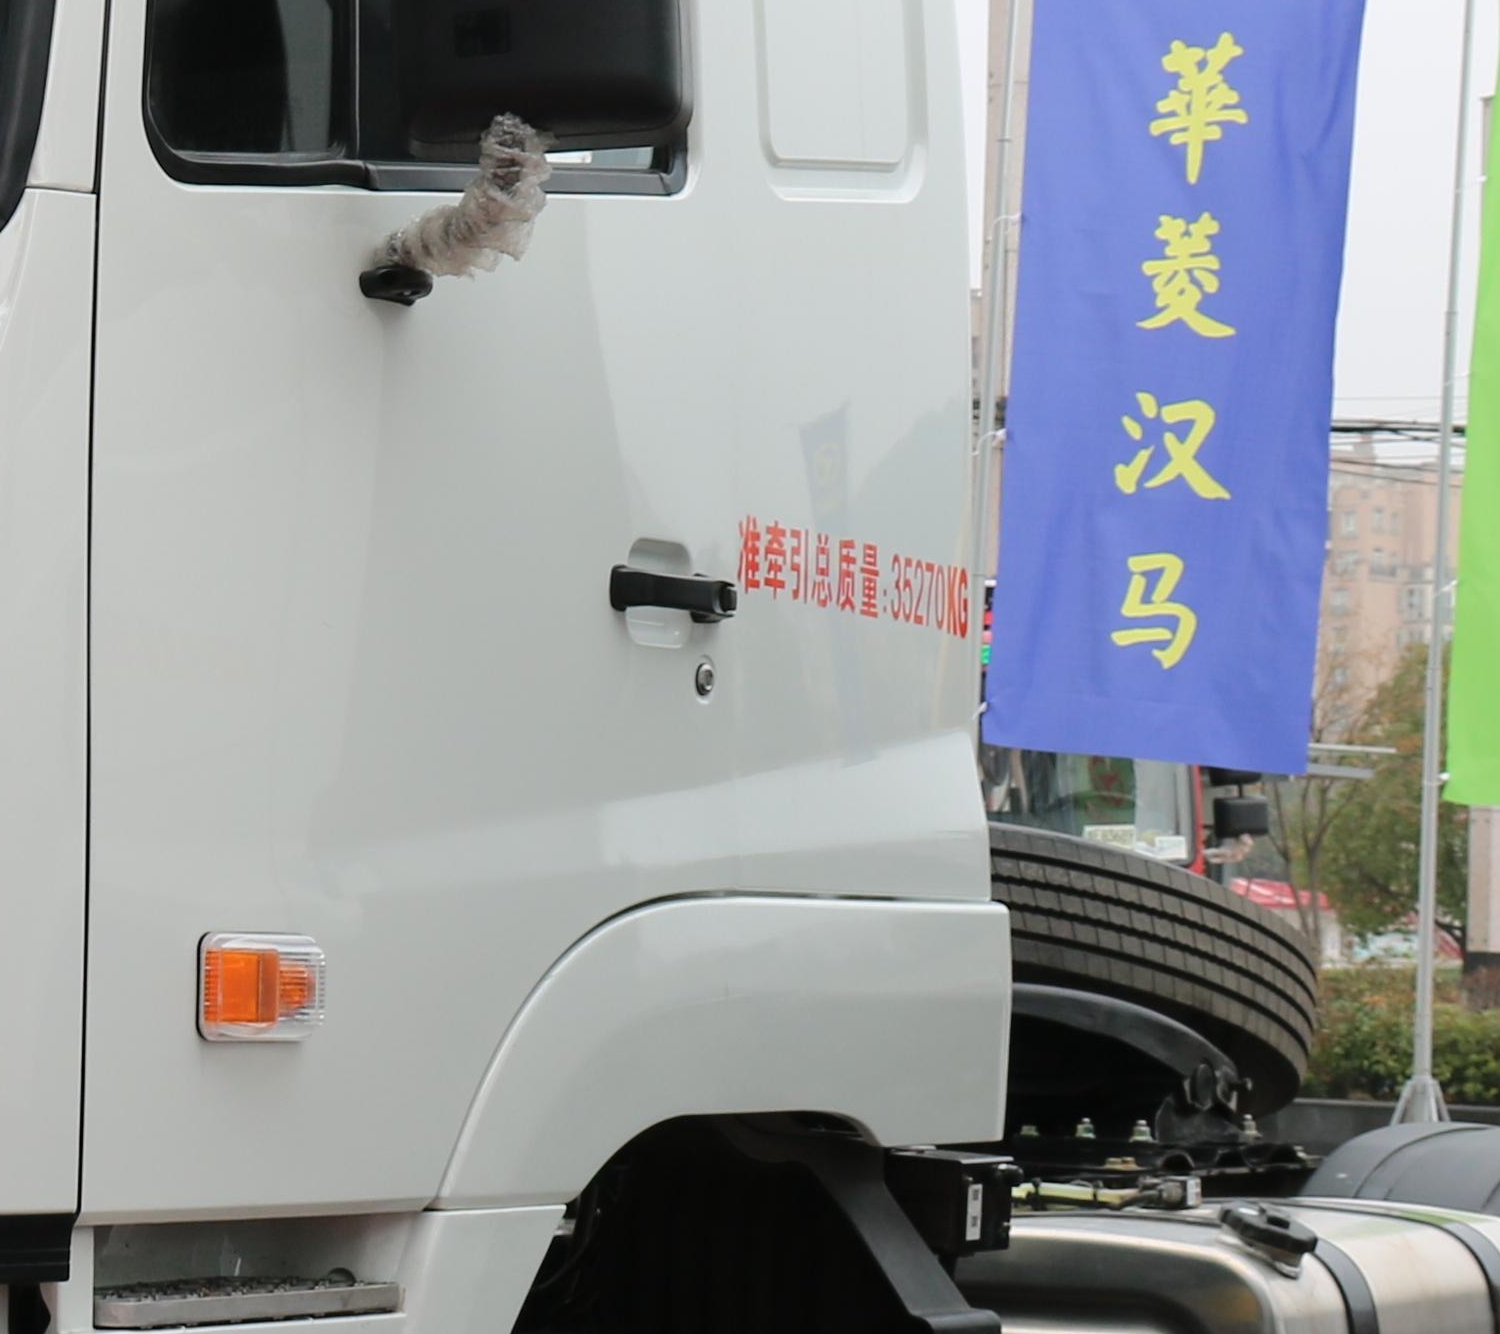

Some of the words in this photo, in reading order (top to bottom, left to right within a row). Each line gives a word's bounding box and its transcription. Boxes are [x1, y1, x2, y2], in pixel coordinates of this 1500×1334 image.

[737, 515, 969, 639] 准牵引总质量:35270KG
